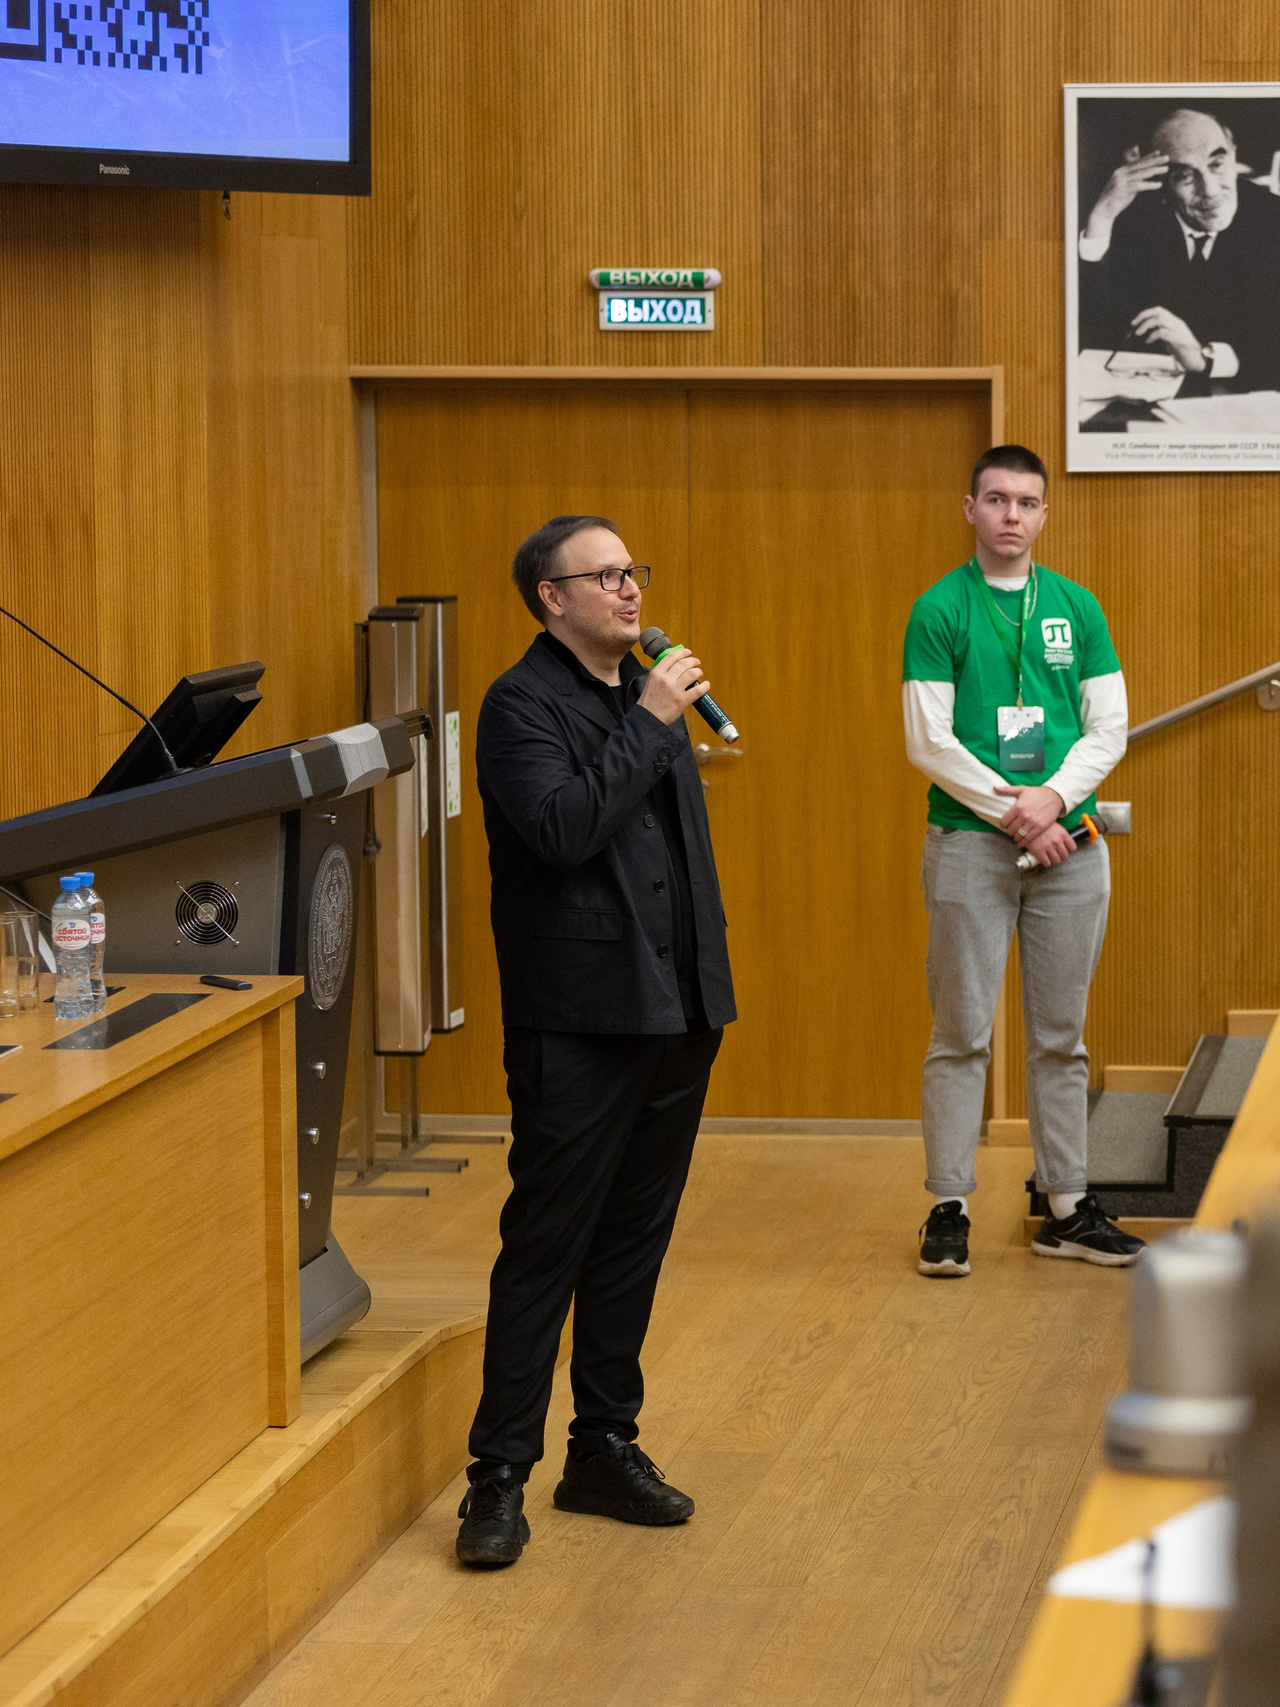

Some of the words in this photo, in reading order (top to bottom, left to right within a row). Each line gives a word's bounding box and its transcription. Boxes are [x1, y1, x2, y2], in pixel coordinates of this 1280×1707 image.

[99, 163, 130, 175] Panasonic
[609, 270, 695, 288] ВЫХОД
[610, 298, 703, 324] ВЫХОД
